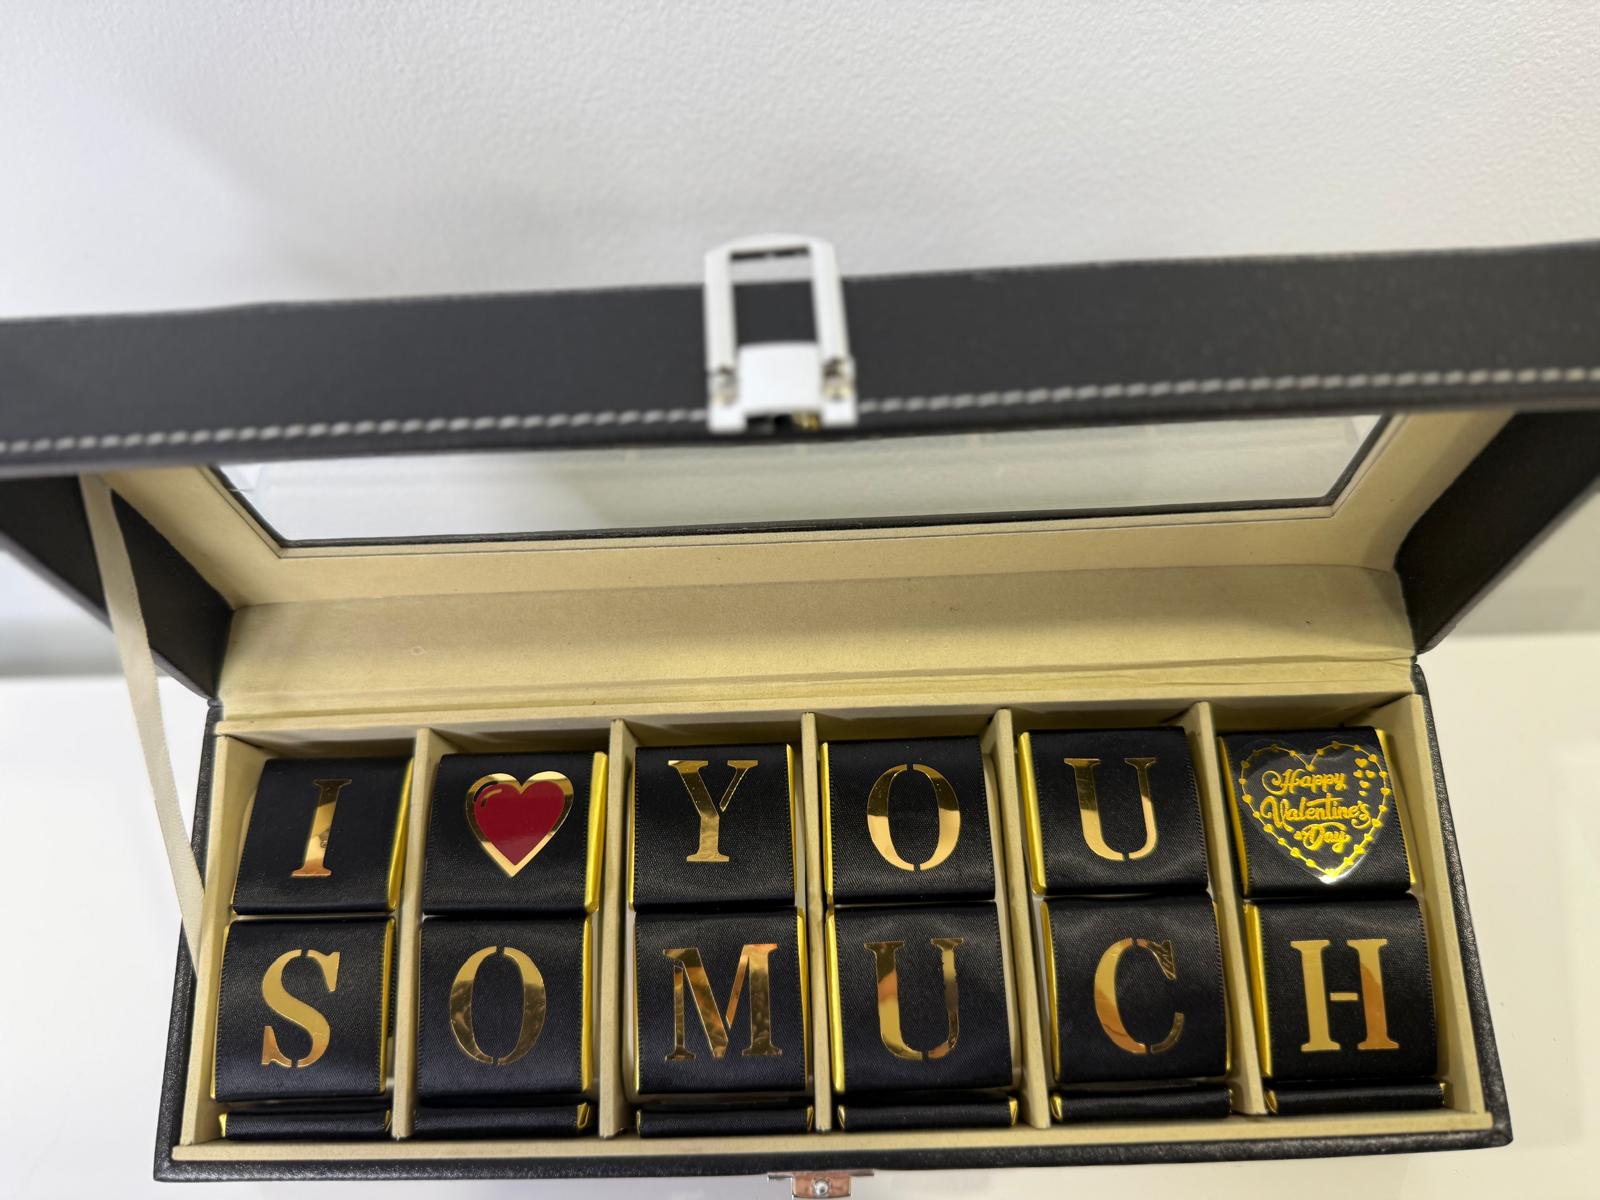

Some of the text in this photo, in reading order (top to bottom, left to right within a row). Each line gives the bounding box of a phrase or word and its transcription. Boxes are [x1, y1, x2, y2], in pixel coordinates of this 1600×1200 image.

[1262, 769, 1347, 795] Happy
[291, 778, 352, 878] I
[1260, 793, 1372, 832] Valentine's
[1293, 822, 1351, 854] Day
